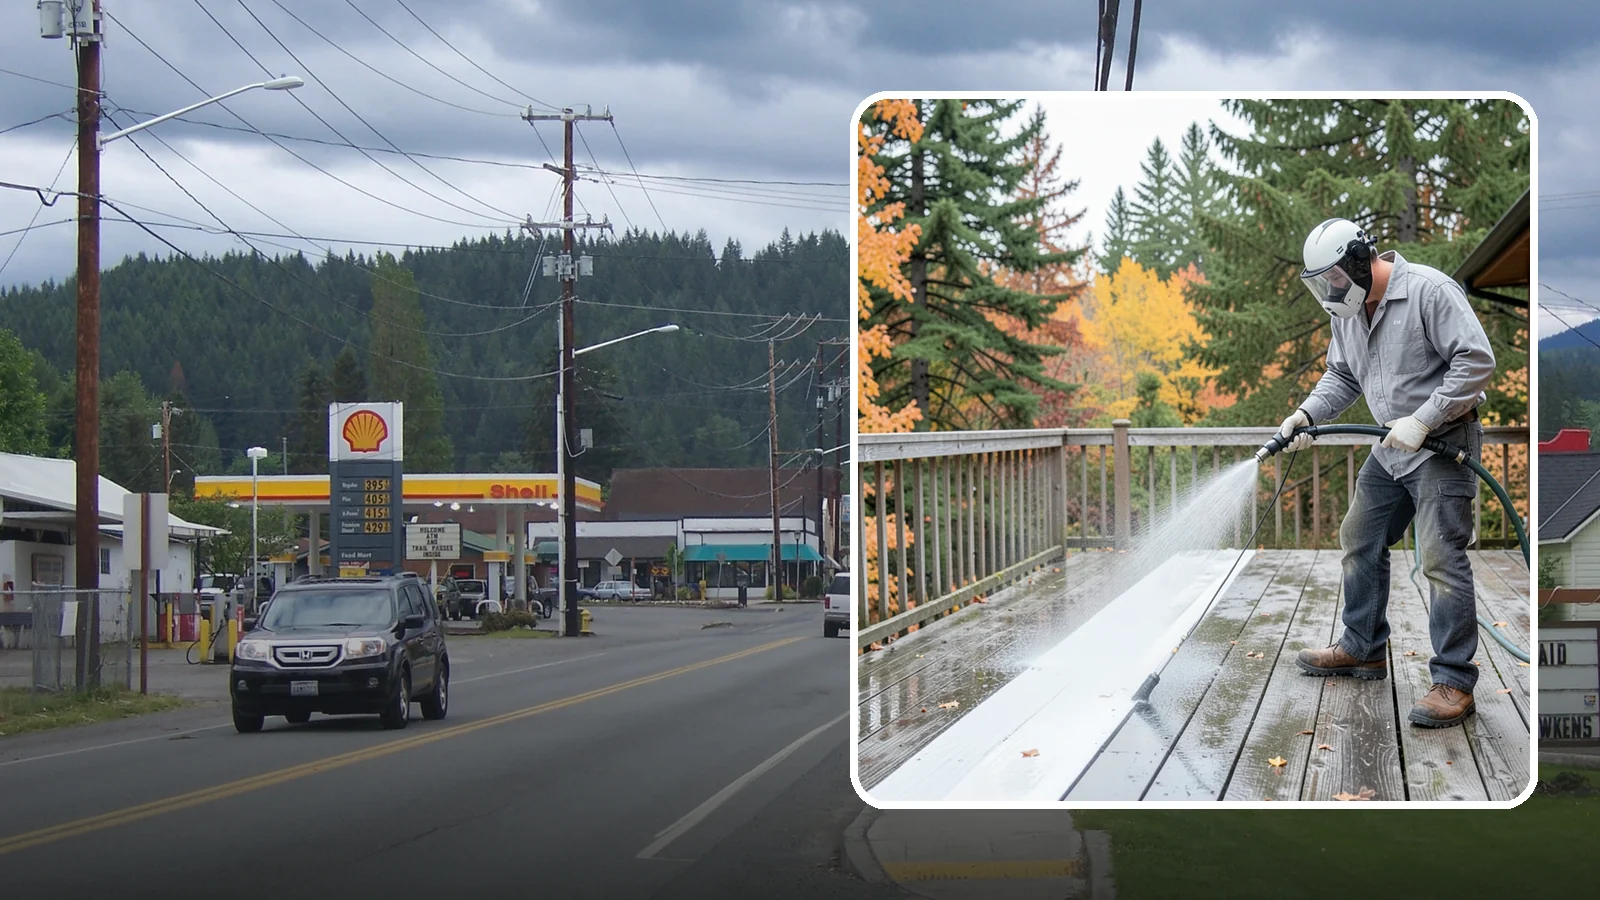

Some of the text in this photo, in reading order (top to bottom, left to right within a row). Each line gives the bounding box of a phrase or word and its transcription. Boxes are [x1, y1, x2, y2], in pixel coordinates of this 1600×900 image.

[365, 480, 383, 490] 395
[490, 484, 548, 499] Shell
[365, 494, 383, 504] 405
[365, 508, 383, 518] 415
[365, 522, 383, 532] 429
